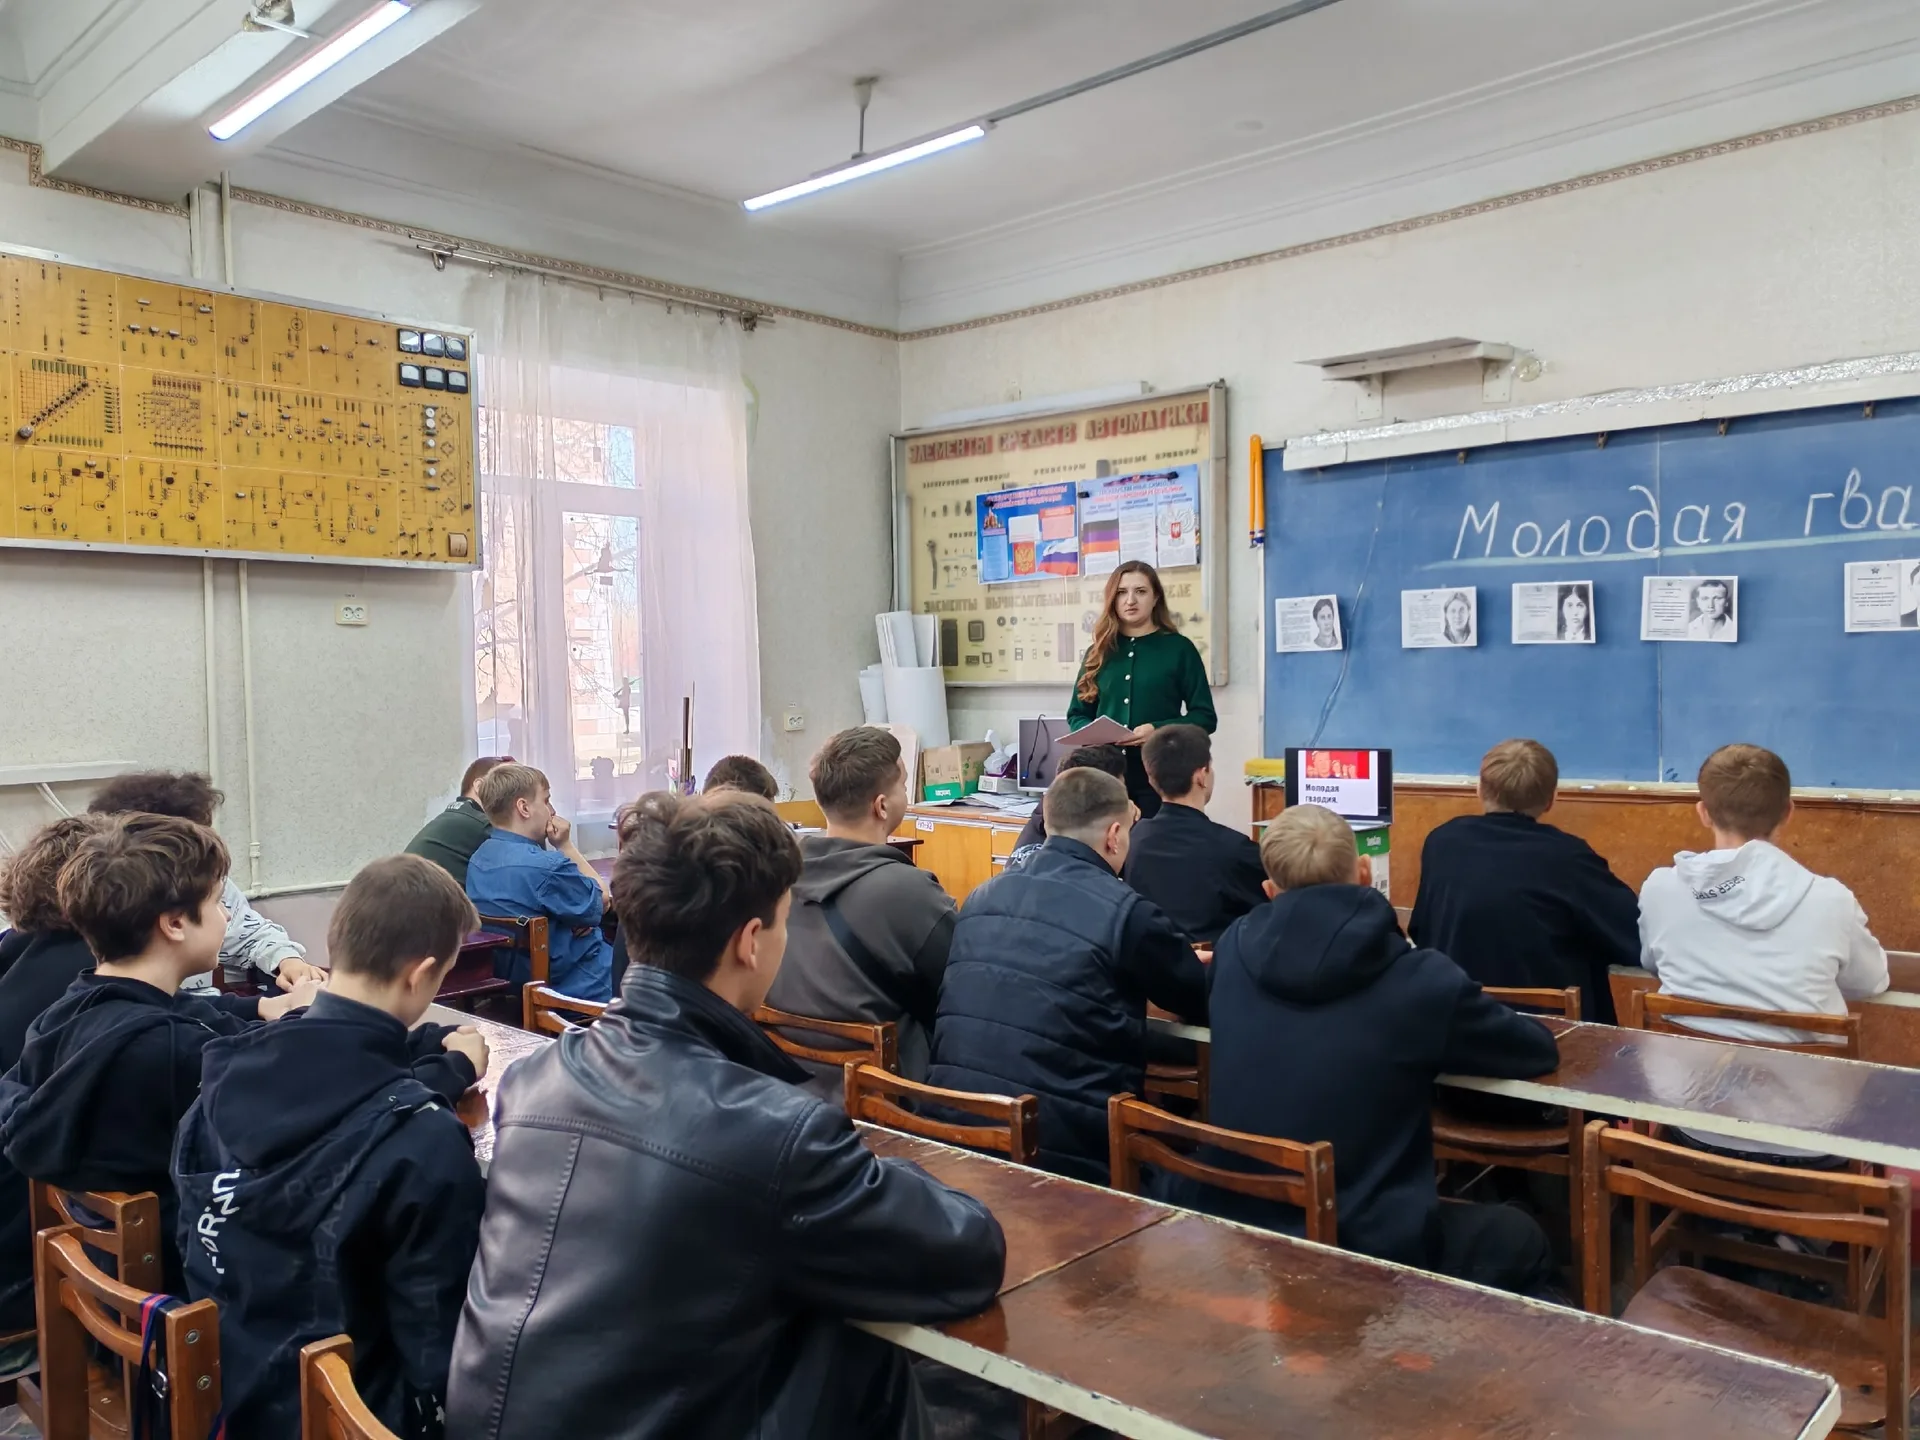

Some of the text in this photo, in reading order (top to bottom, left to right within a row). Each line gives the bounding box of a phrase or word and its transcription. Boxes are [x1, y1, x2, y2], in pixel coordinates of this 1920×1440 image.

[1085, 402, 1209, 440] АВТОМАТИКИ
[1453, 484, 1746, 559] Молодая
[1305, 784, 1340, 793] Молодая
